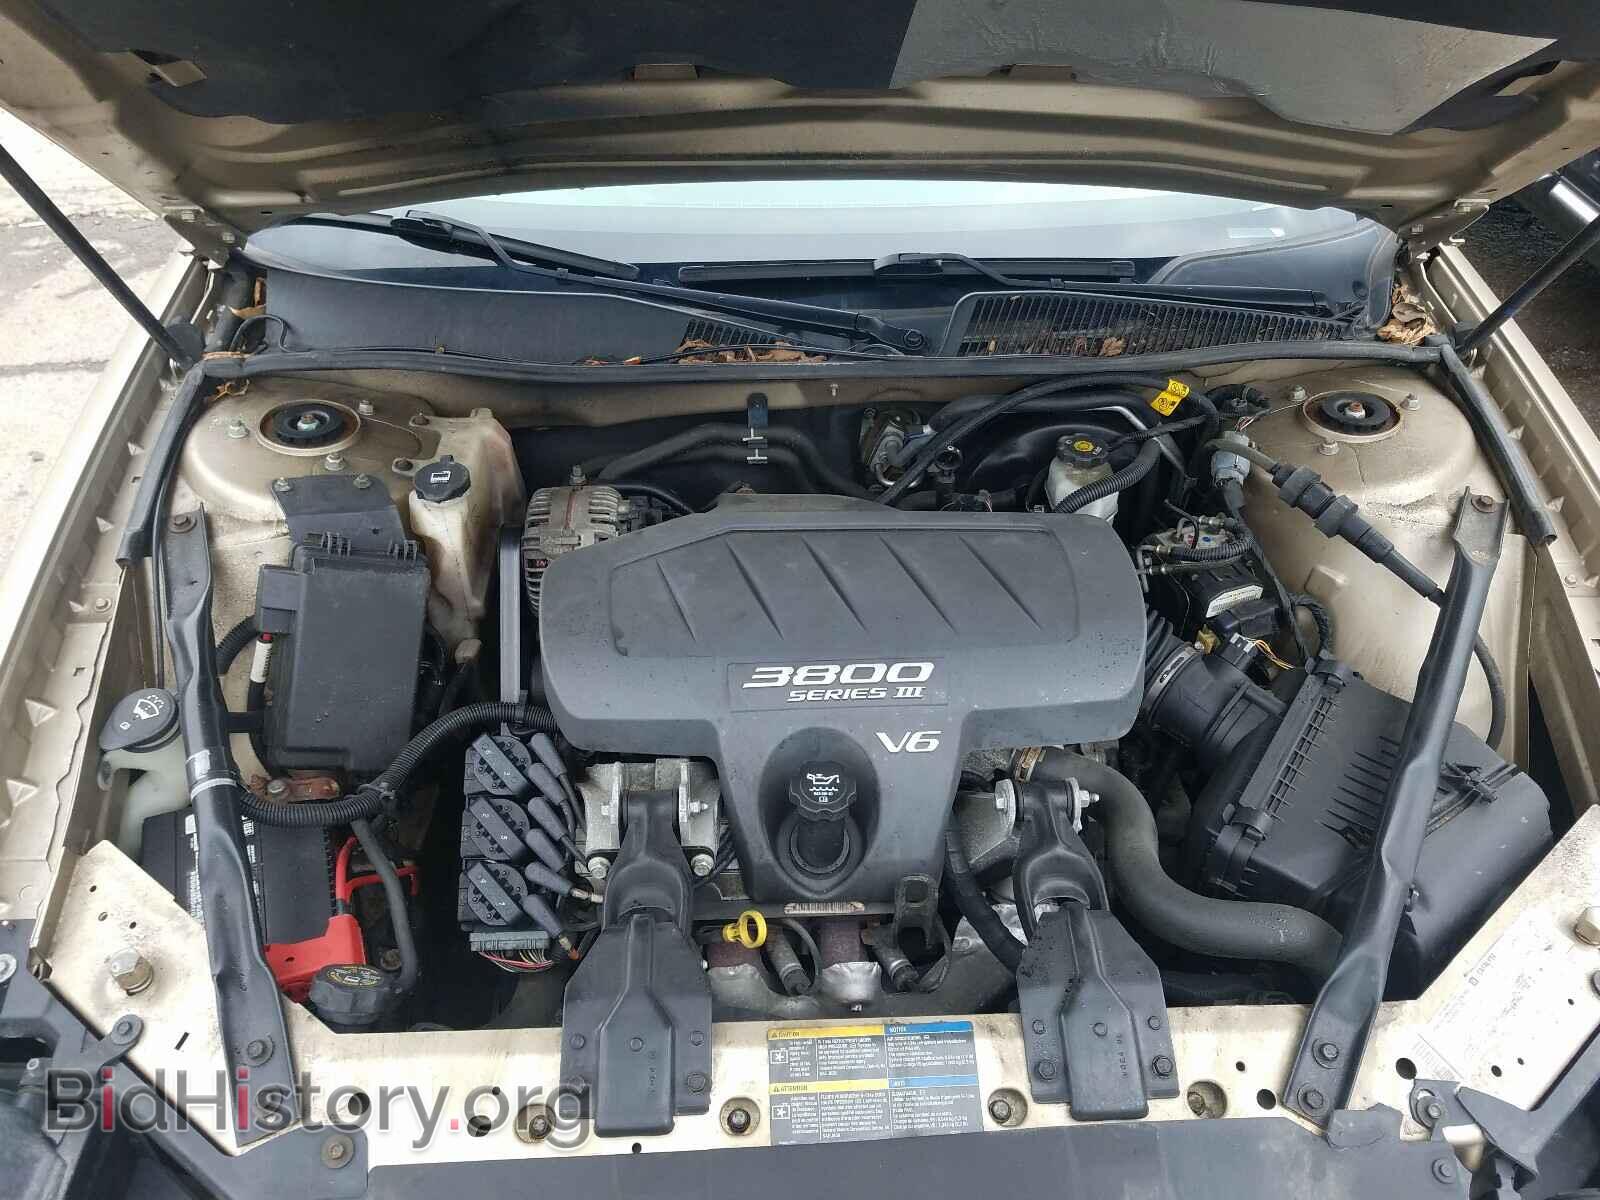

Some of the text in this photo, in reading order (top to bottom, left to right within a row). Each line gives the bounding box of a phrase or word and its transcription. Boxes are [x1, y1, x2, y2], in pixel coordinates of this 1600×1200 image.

[742, 662, 935, 689] 3800
[787, 686, 926, 702] SERIES III
[876, 730, 943, 753] V6
